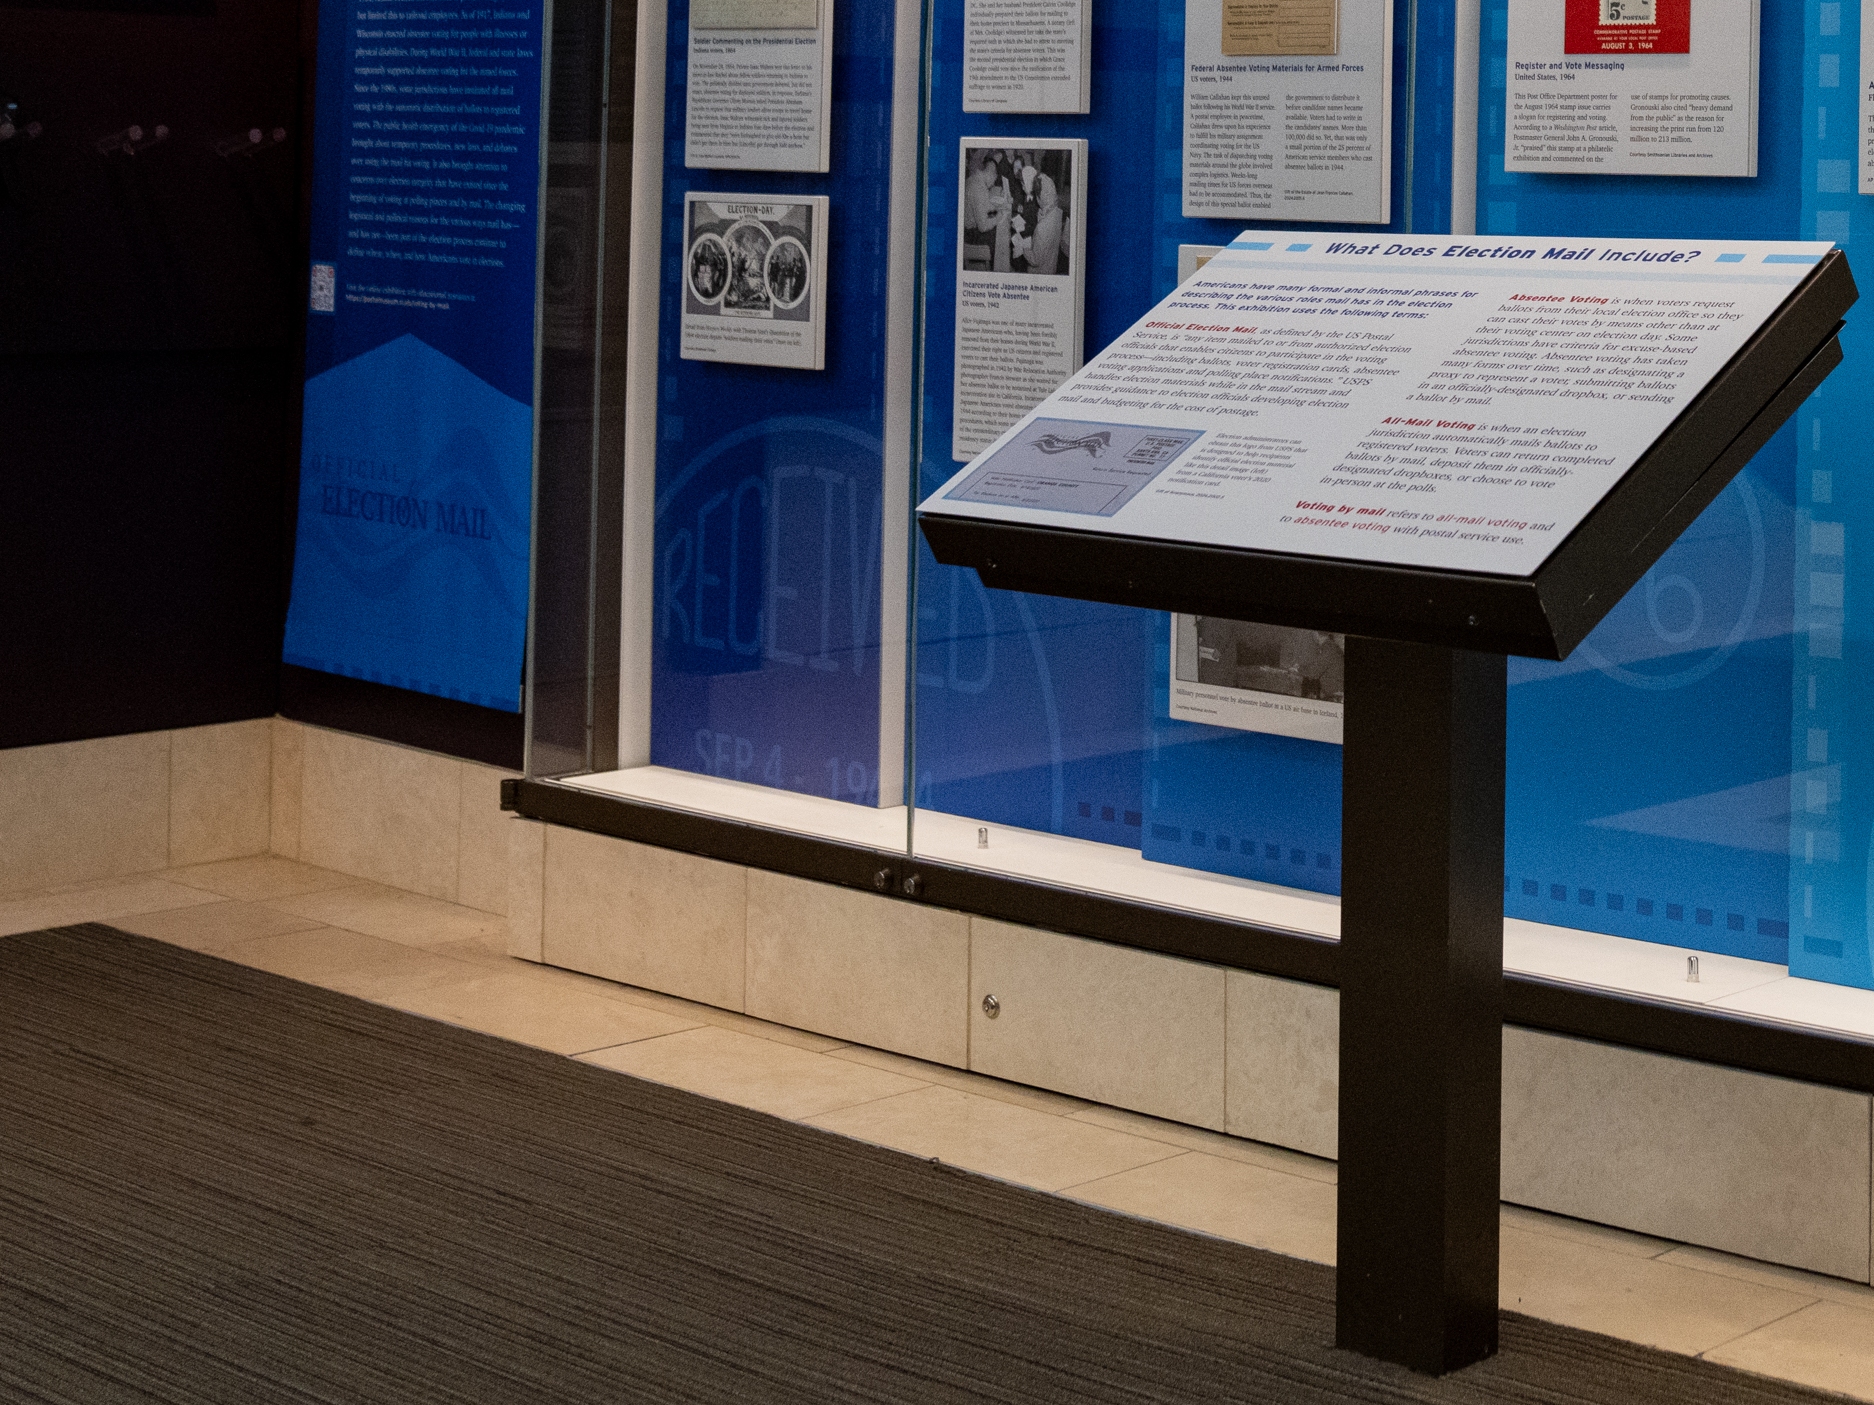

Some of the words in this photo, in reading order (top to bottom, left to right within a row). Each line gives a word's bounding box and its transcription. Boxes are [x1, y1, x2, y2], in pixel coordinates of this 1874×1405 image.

[1191, 64, 1214, 72] Federal
[1217, 64, 1247, 72] Absentee
[1249, 64, 1270, 73] Voting
[1272, 64, 1303, 72] Materials
[1305, 64, 1315, 72] for
[1317, 64, 1339, 72] Armed
[1342, 64, 1364, 72] Forces
[1515, 62, 1547, 71] Register
[1549, 61, 1562, 69] and
[1585, 62, 1624, 71] Messaging
[1538, 73, 1557, 81] States,
[1560, 73, 1575, 81] 1964
[1325, 243, 1378, 256] What
[1383, 244, 1436, 258] Does
[1443, 245, 1537, 259] Election
[1543, 248, 1593, 260] Mail
[1599, 249, 1701, 263] Include?
[1381, 417, 1433, 427] All-Mail
[1436, 420, 1476, 431] Voting
[1490, 424, 1521, 433] when
[1541, 428, 1587, 437] election
[1295, 501, 1334, 513] Voting
[1338, 505, 1353, 515] by
[1357, 507, 1386, 517] mail
[1387, 509, 1420, 520] refers
[1421, 512, 1434, 521] to
[1436, 513, 1485, 525] all-mail
[1487, 517, 1527, 530] voting
[1529, 522, 1555, 531] and
[1293, 515, 1349, 528] absentee
[1352, 522, 1391, 534] voting
[1392, 525, 1419, 535] with
[1420, 528, 1459, 540] postal
[1459, 531, 1500, 542] service
[1502, 536, 1525, 545] use.
